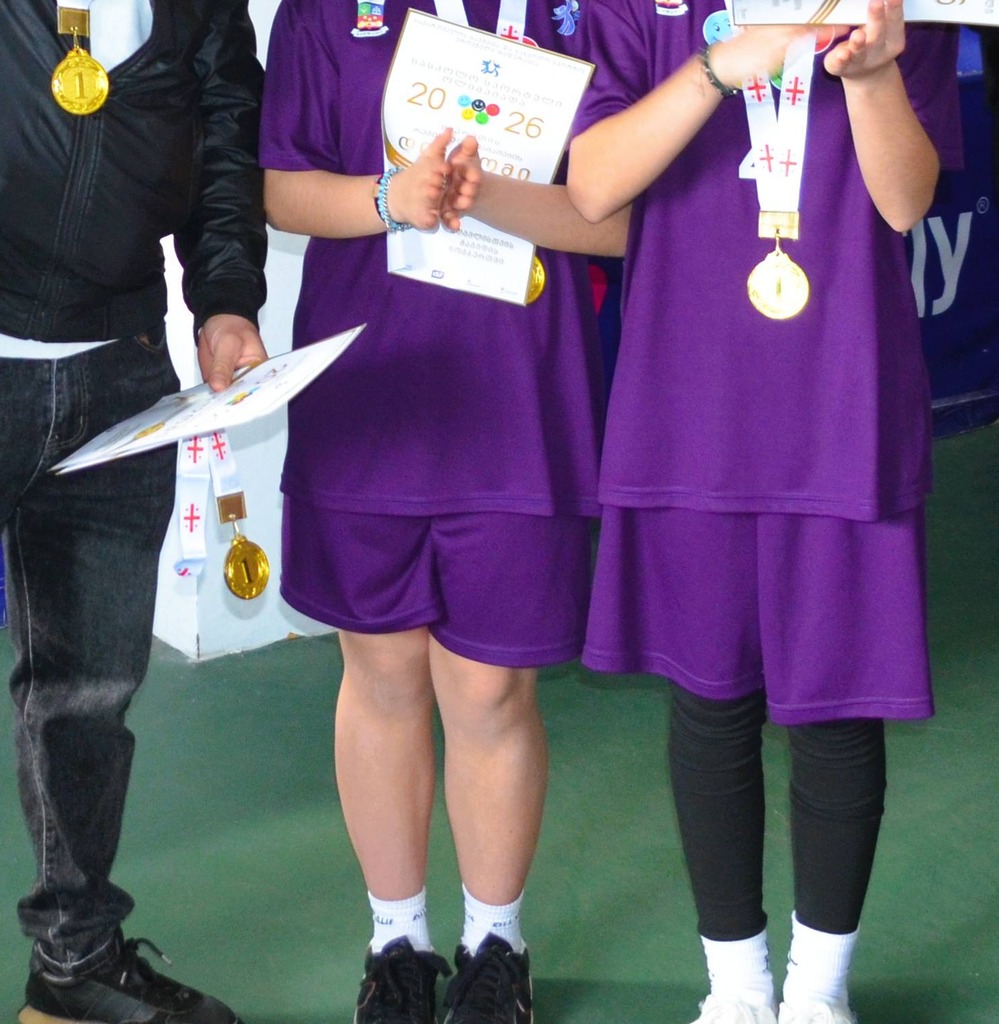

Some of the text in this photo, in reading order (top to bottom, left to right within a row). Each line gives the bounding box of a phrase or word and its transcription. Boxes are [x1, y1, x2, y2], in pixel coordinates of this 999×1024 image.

[74, 71, 87, 99] 1
[406, 81, 545, 139] 20 26
